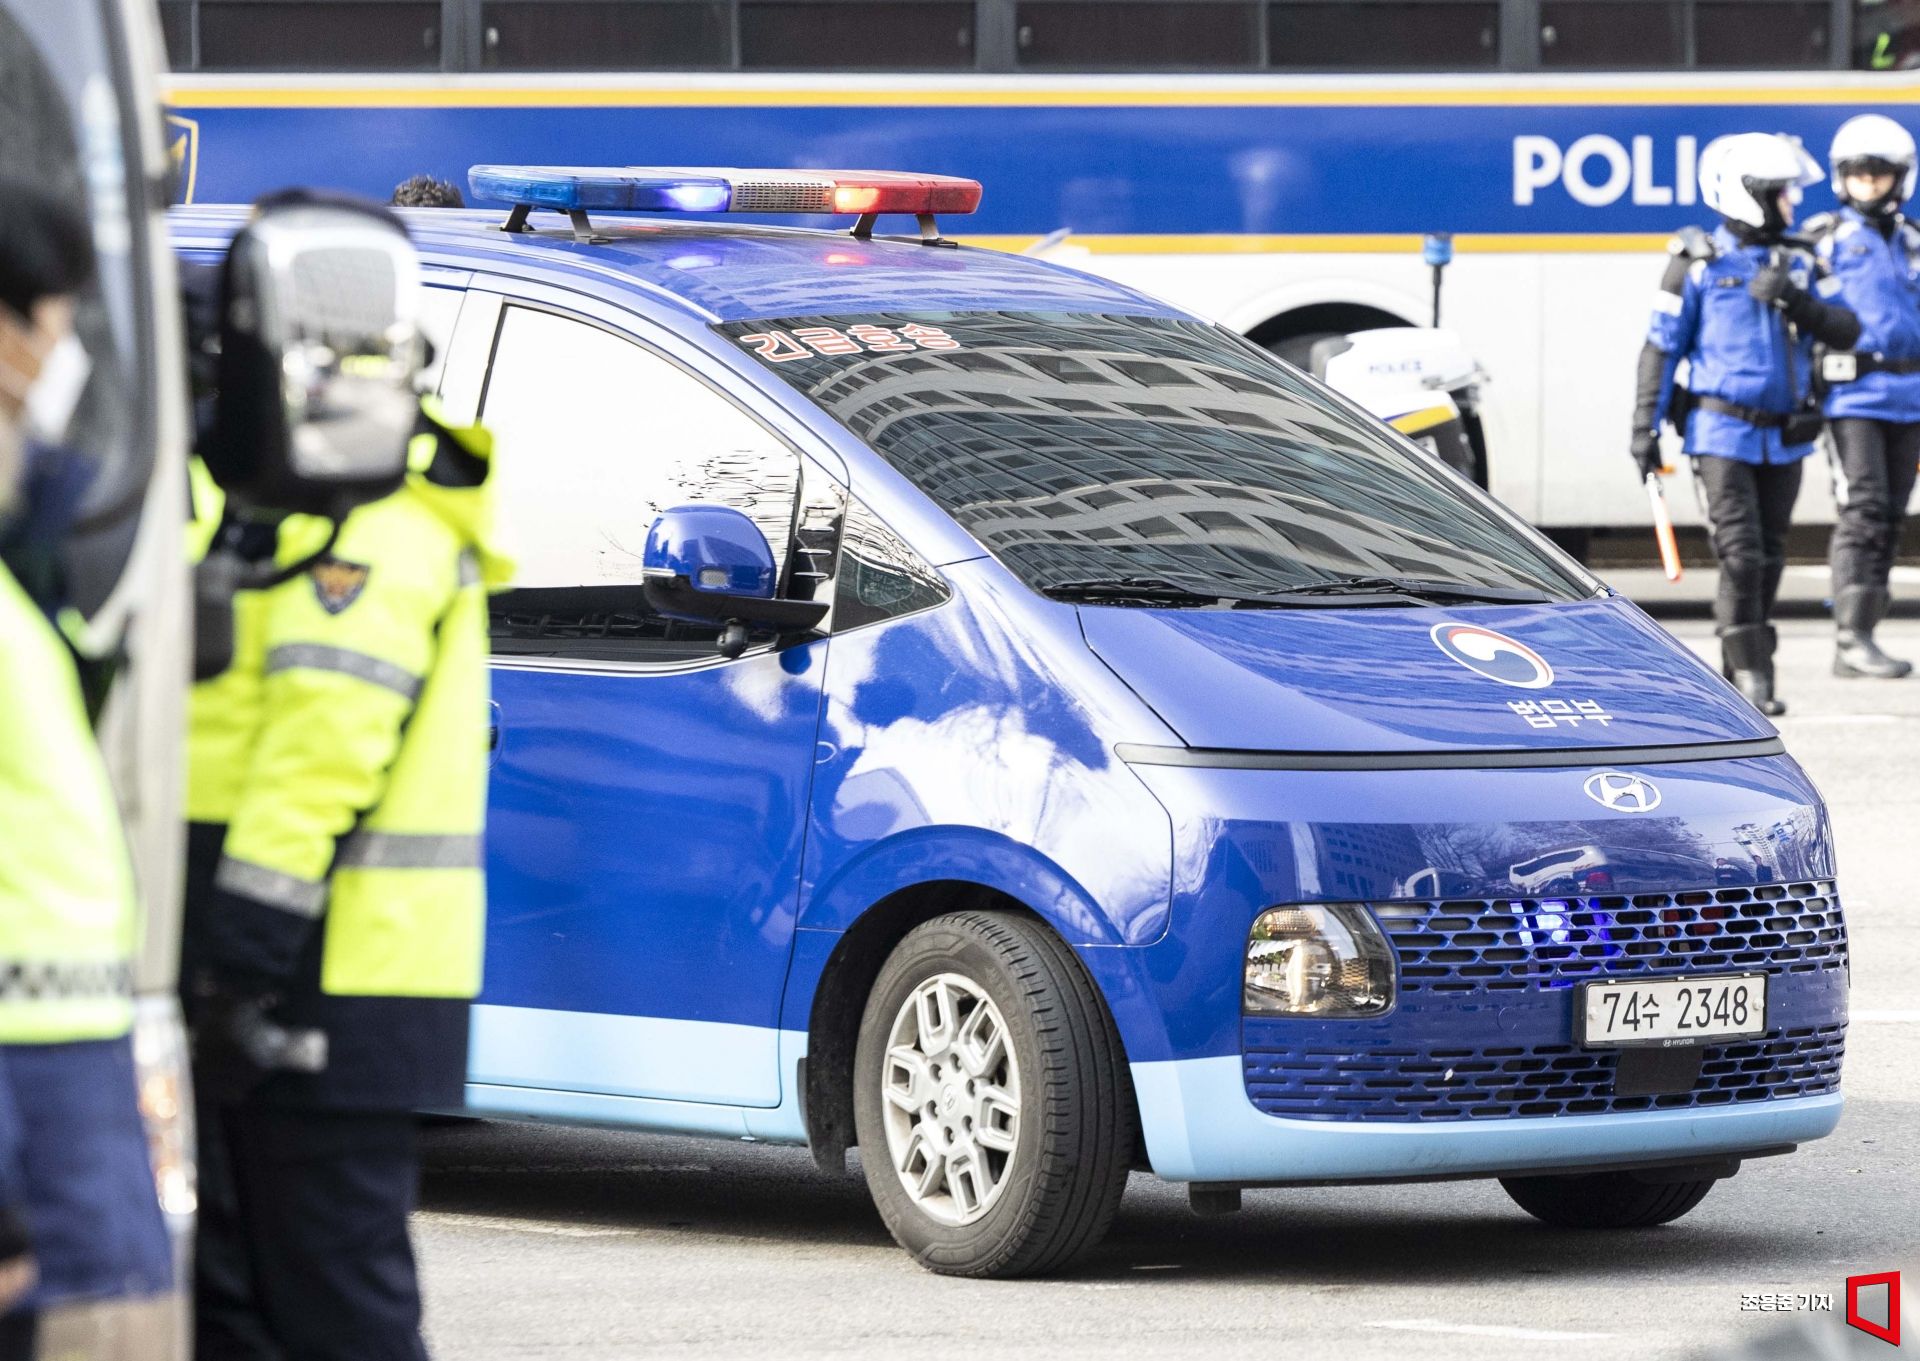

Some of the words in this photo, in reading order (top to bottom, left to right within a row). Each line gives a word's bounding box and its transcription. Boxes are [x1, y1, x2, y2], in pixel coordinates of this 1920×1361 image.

[1512, 133, 1803, 206] POLI
[739, 323, 961, 362] 긴급호송
[1506, 699, 1614, 729] 법무부
[1602, 991, 1660, 1033] 74수
[1677, 985, 1748, 1030] 2348
[1672, 1038, 1695, 1046] HYUNDAI
